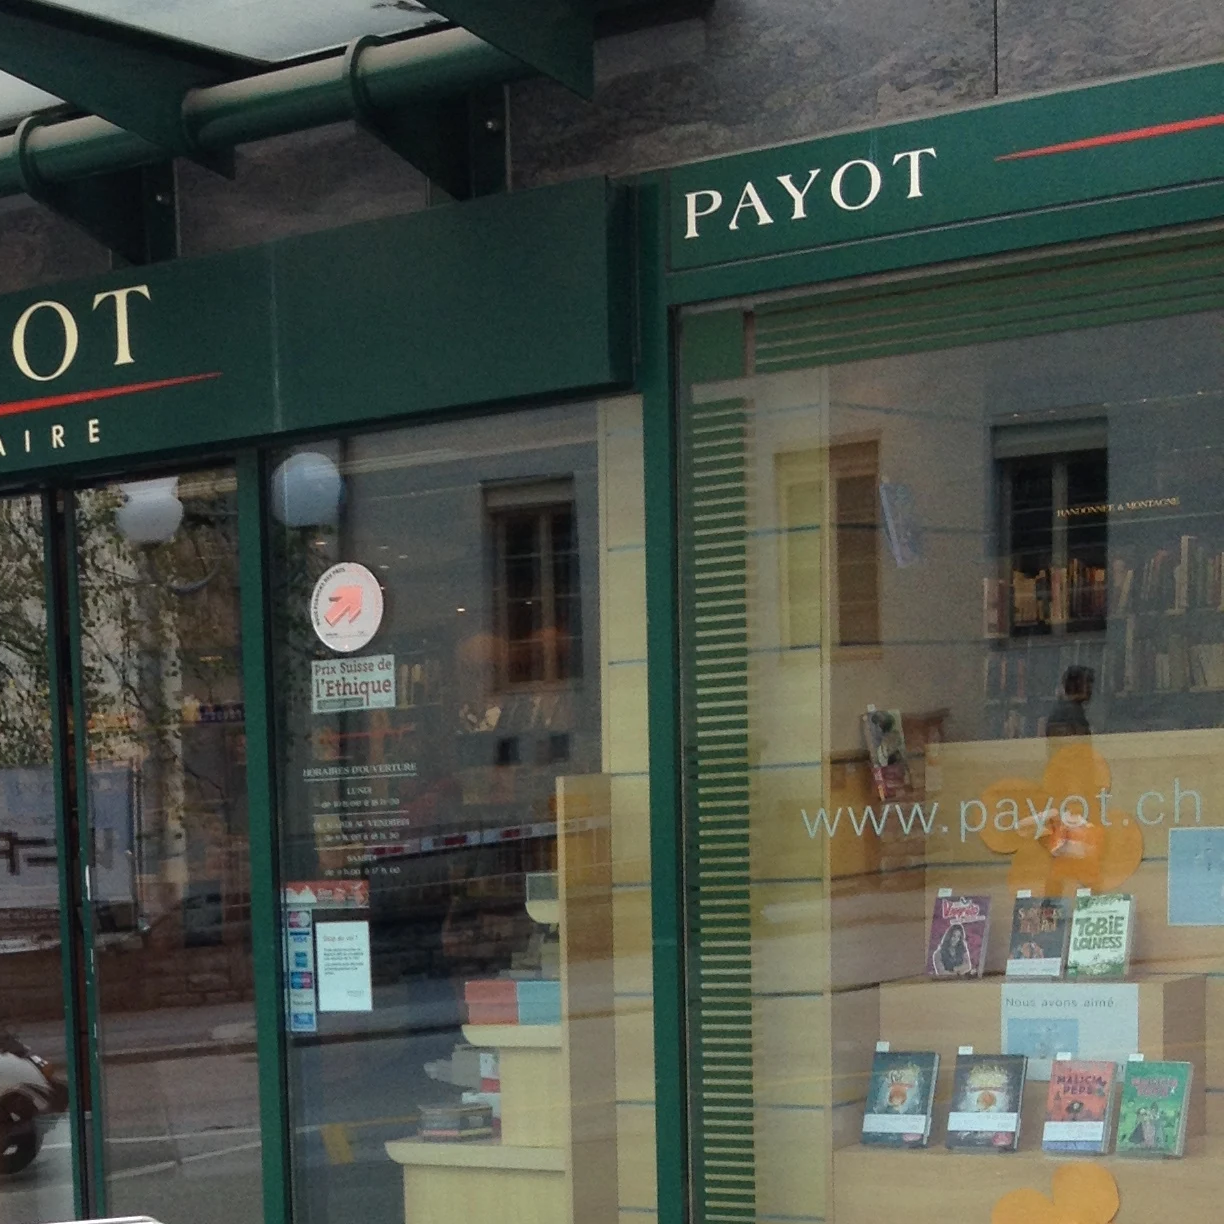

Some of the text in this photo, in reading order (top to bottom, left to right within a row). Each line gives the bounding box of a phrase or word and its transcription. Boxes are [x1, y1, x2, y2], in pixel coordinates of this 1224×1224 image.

[684, 147, 937, 239] PAYOT
[314, 657, 392, 676] Prix Suisse de
[315, 676, 392, 706] l'Ethique
[800, 777, 1203, 843] www.payot.ch
[1005, 997, 1036, 1008] Nous
[1041, 999, 1078, 1008] avons
